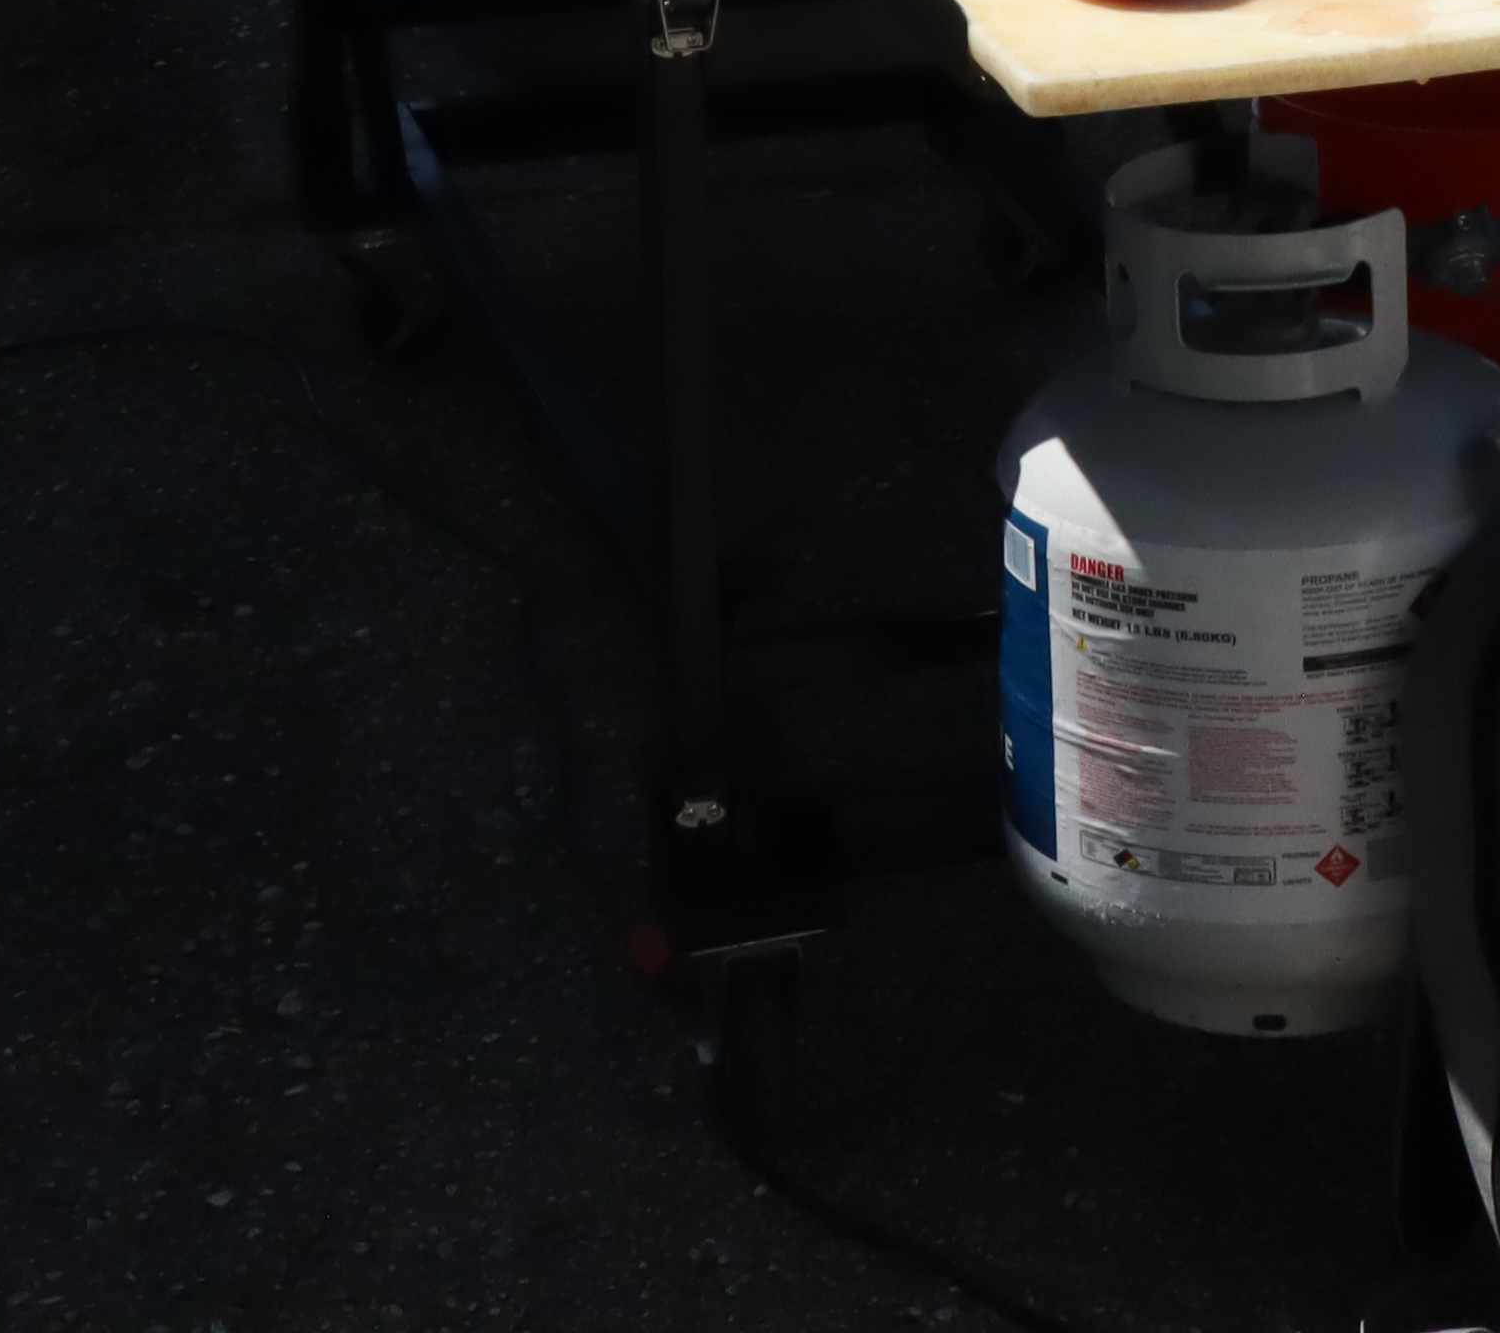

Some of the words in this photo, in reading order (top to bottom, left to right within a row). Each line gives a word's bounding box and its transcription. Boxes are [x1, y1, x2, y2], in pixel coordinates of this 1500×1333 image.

[1070, 552, 1126, 582] DANGER
[1301, 571, 1360, 586] PROPANE
[1145, 626, 1171, 639] LBS
